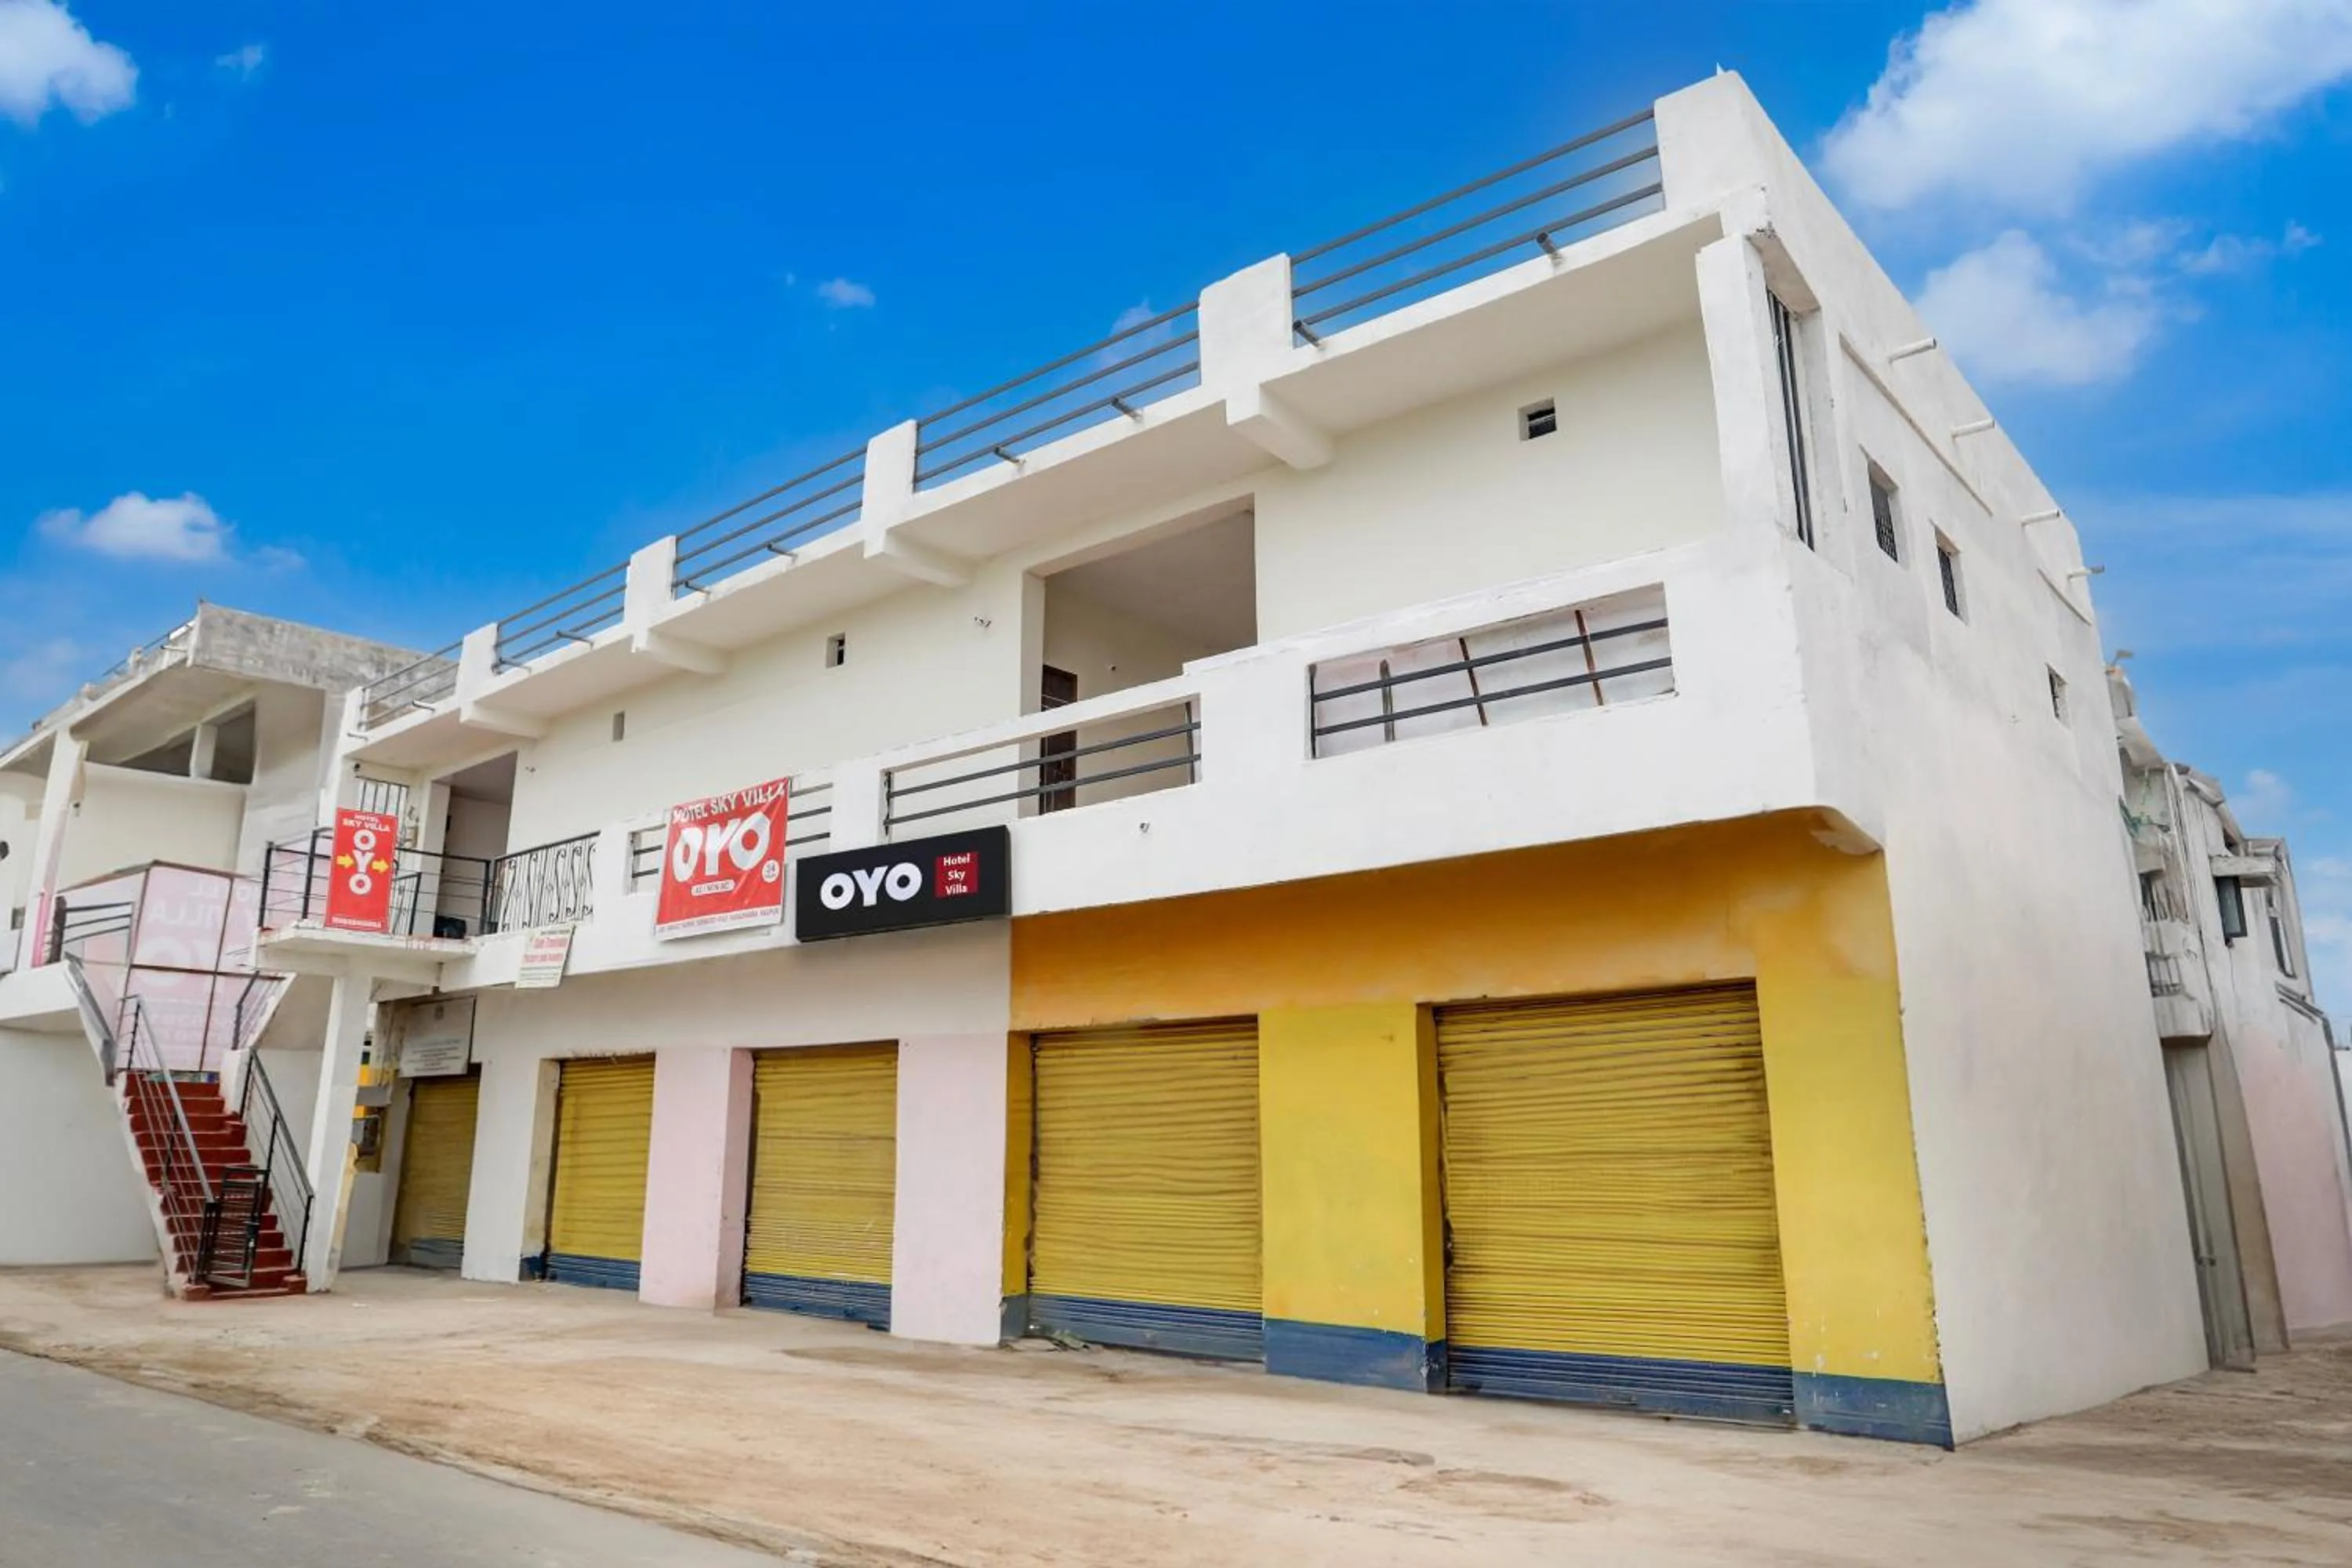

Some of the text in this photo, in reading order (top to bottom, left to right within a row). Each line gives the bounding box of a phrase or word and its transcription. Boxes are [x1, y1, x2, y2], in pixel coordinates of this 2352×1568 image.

[710, 793, 739, 815] SKY
[342, 818, 390, 833] SKY VILLA
[354, 815, 379, 823] HOTEL
[673, 811, 771, 883] OYO
[349, 829, 376, 895] OYO
[943, 853, 971, 866] Hotel
[948, 869, 966, 882] Sky
[820, 862, 923, 910] OYO
[945, 884, 968, 895] Villa
